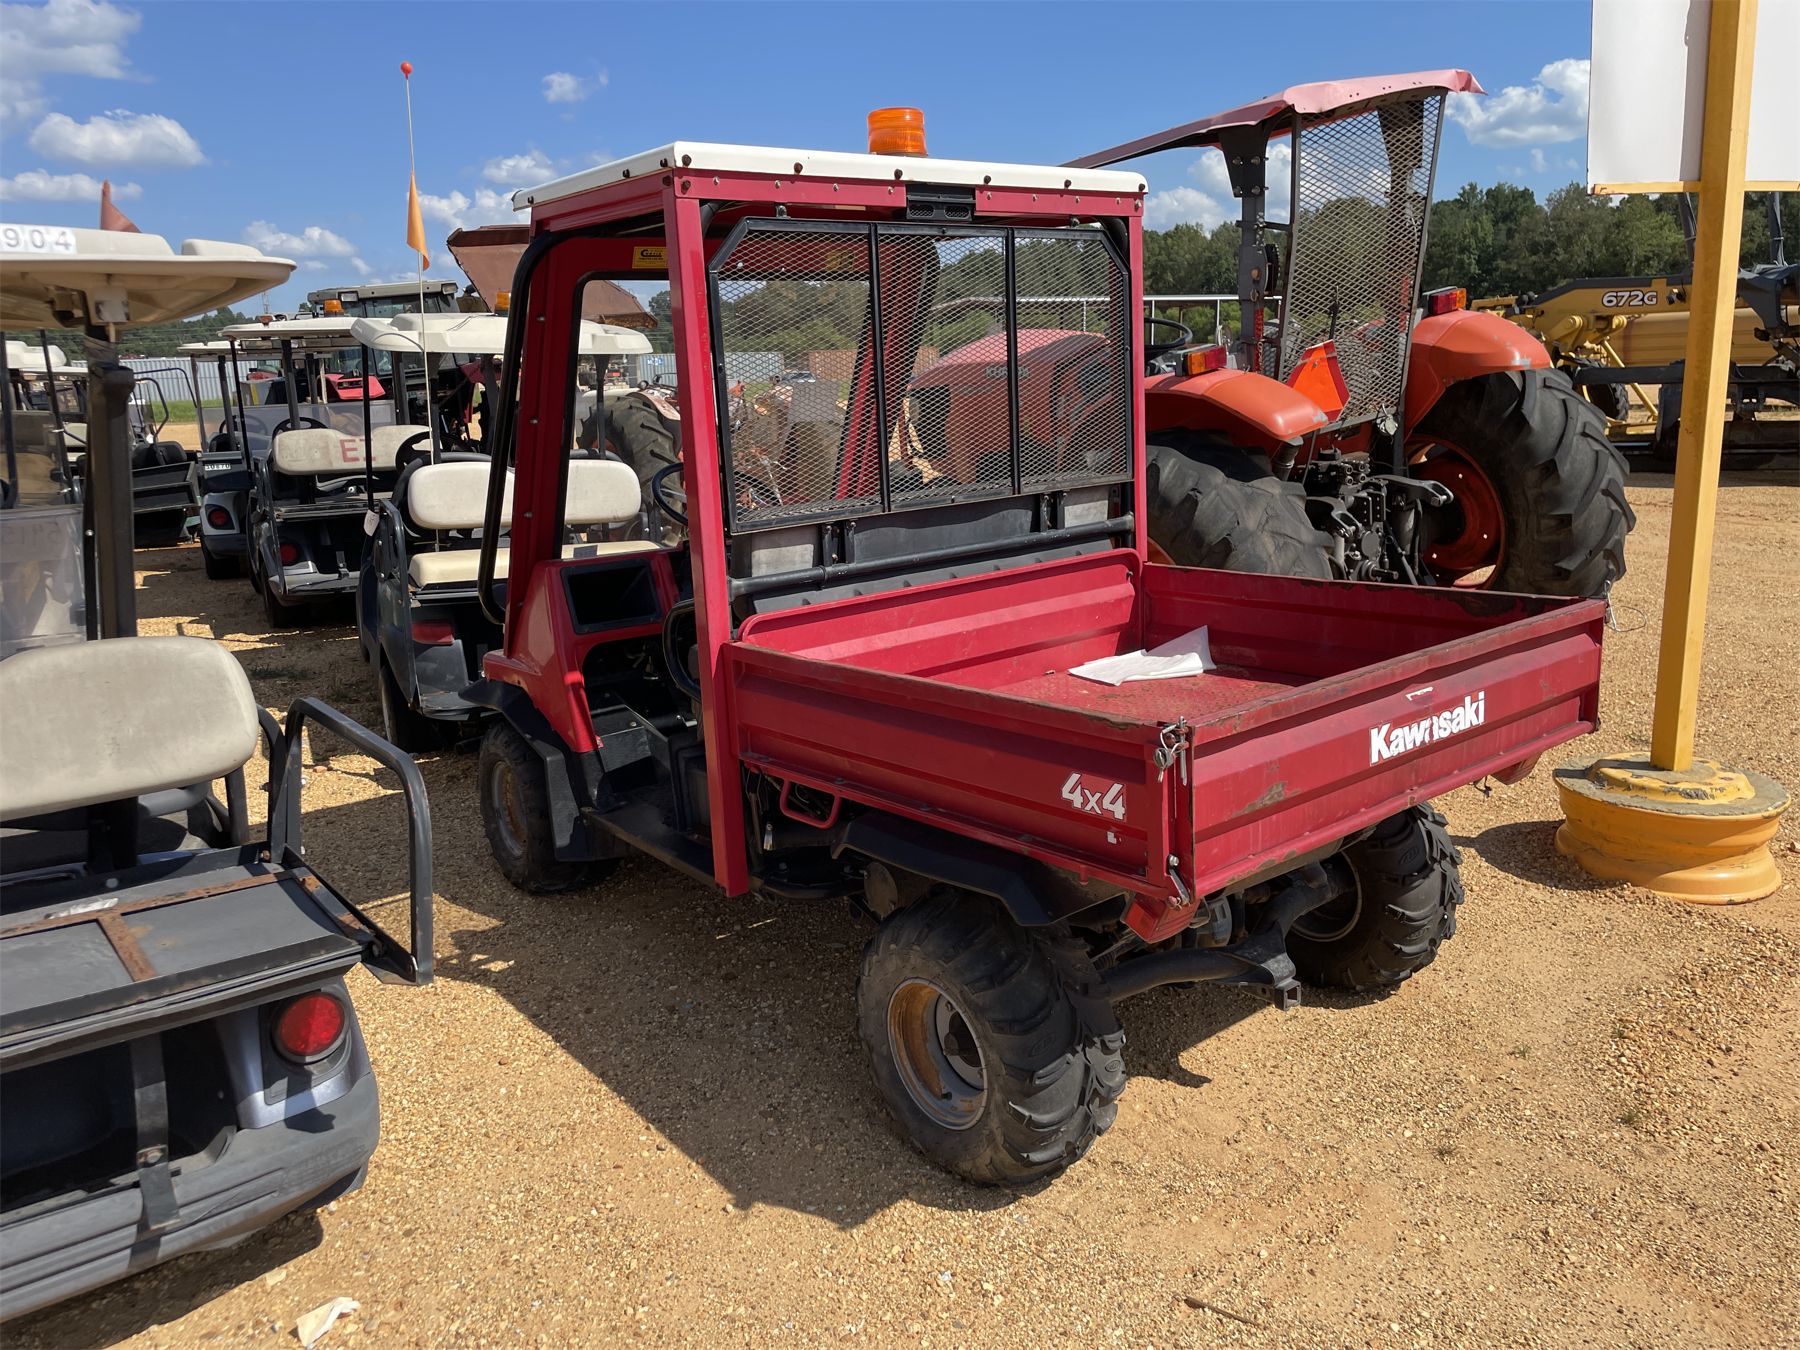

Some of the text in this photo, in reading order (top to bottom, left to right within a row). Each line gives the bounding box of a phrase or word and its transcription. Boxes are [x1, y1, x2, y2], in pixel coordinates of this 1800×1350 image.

[3, 228, 72, 250] 904
[1602, 290, 1657, 307] 672G
[1370, 691, 1485, 765] Kawasaki
[1061, 772, 1126, 820] 4x4
